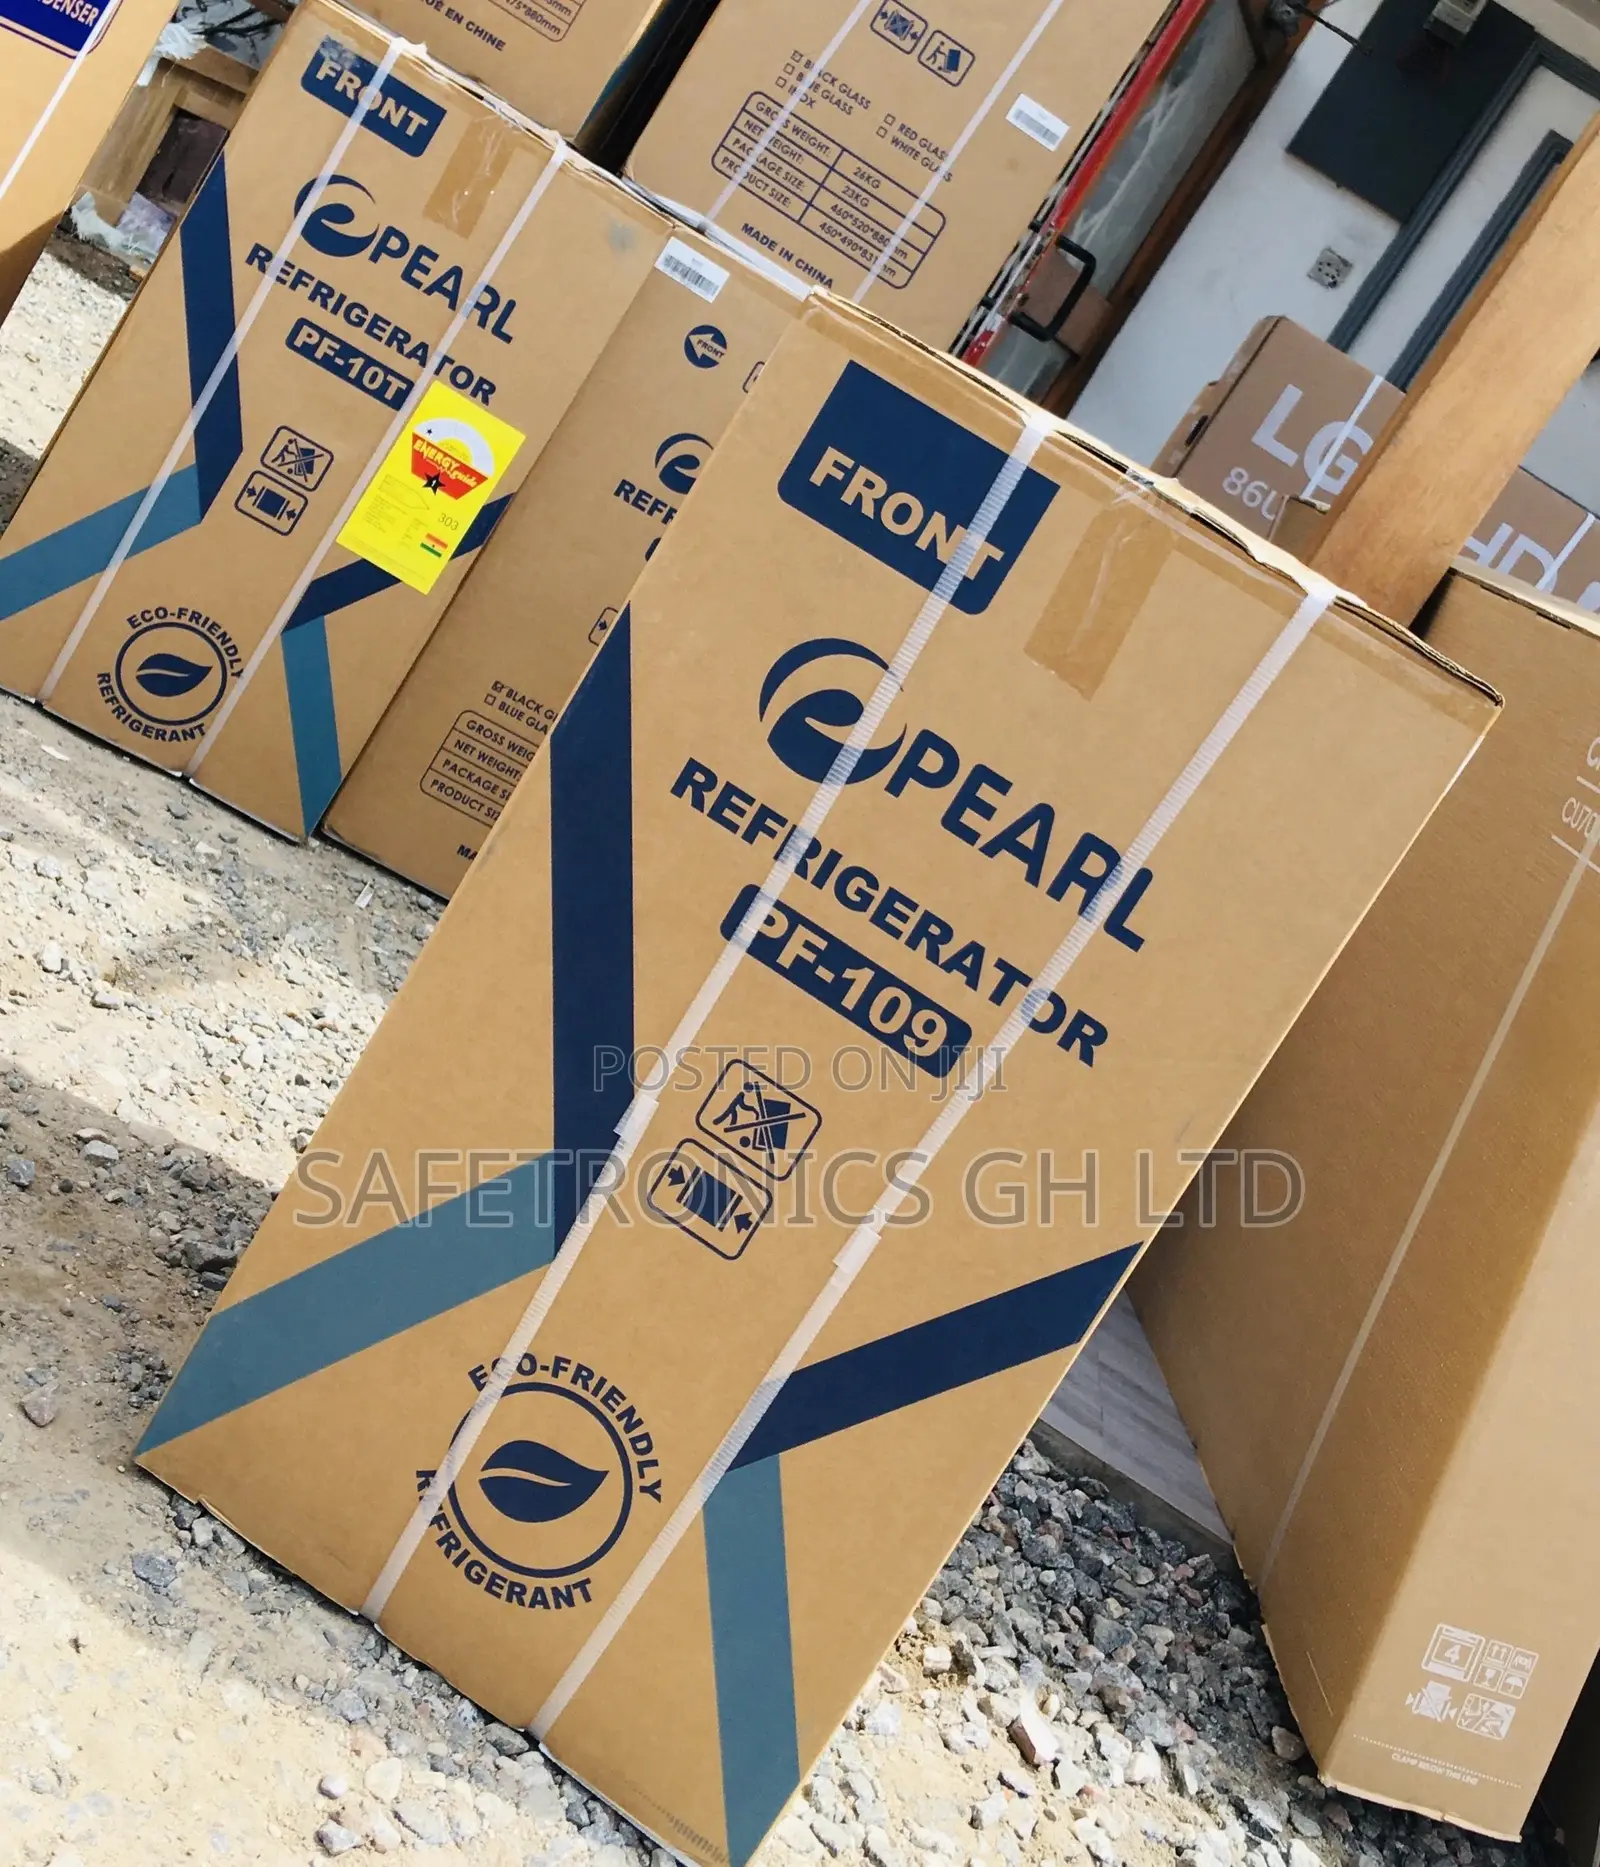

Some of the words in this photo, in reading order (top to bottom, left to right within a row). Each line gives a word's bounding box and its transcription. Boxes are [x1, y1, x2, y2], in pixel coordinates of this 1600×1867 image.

[444, 8, 464, 24] EN
[465, 21, 506, 51] CHINE
[316, 58, 429, 137] FRONT
[821, 89, 854, 115] GLASS
[839, 83, 871, 110] GLASS
[744, 120, 765, 137] NET
[897, 123, 918, 141] RED
[891, 136, 921, 161] WHITE
[852, 166, 882, 190] 26KG
[769, 184, 792, 208] SIZE:
[841, 185, 870, 208] 23KG
[741, 223, 778, 251] MADE
[779, 247, 794, 263] IN
[795, 257, 834, 290] CHINA
[245, 243, 497, 406] REFRIGERATOR
[696, 338, 726, 359] FRONT
[293, 325, 407, 401] PF-10T
[1251, 383, 1374, 496] LG
[413, 438, 461, 472] ENERGY
[437, 512, 460, 531] 303
[808, 446, 1005, 581] FRONT
[126, 606, 244, 679] ECO-FRIENDLY
[97, 672, 206, 743] REFRIGERANT
[498, 701, 525, 721] BLUE
[505, 688, 544, 715] BLACK
[466, 719, 505, 746] GROSS
[454, 739, 475, 756] NET
[442, 758, 499, 794] PACKAGE
[430, 778, 485, 812] PRODUCT
[670, 757, 1110, 1068] REFRIGERATOR
[745, 904, 948, 1058] PF-109
[1418, 1760, 1445, 1776] BELOW
[1462, 1774, 1480, 1786] LINE
